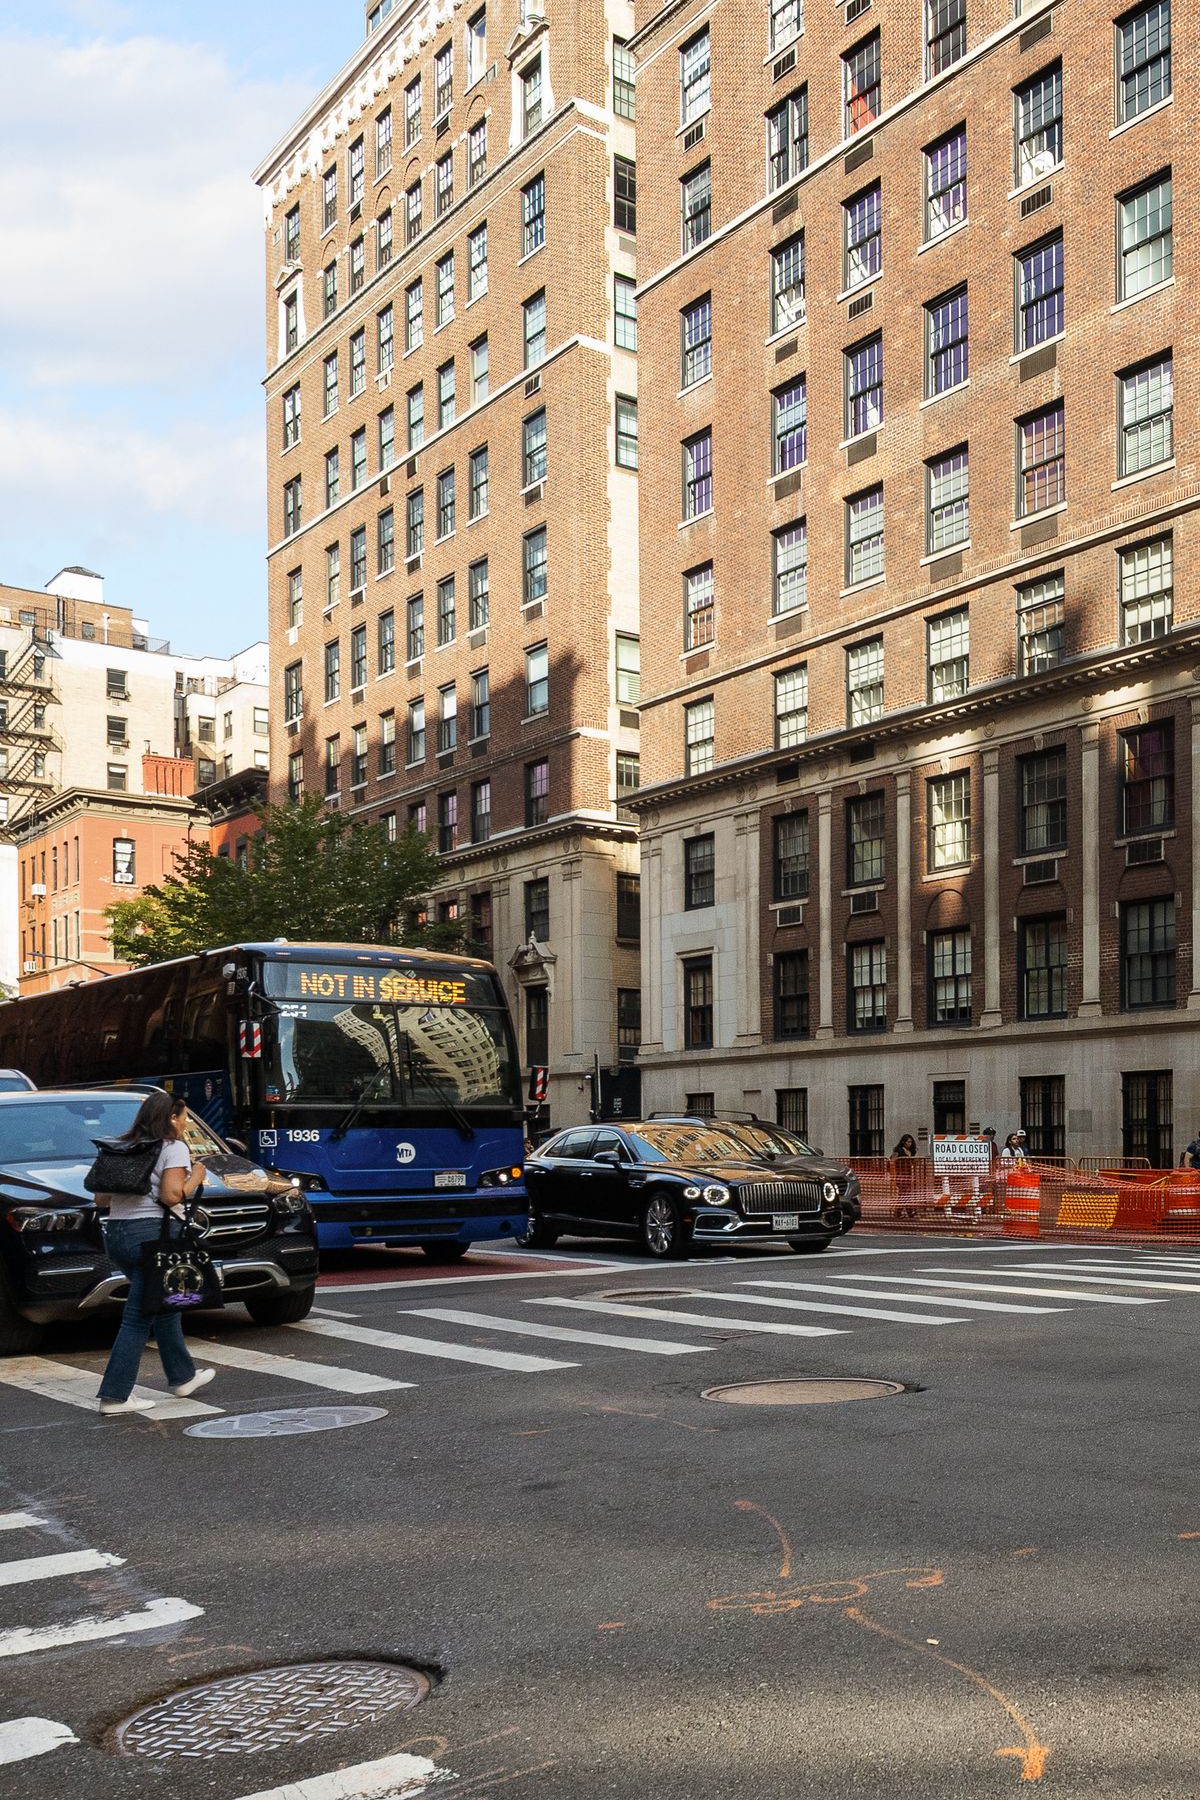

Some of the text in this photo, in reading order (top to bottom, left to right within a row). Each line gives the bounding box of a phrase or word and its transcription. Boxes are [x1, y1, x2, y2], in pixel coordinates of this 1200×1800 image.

[300, 972, 466, 1003] NOT IN SERVICE
[285, 1129, 320, 1142] 1936
[935, 1143, 989, 1153] ROAD CLOSED
